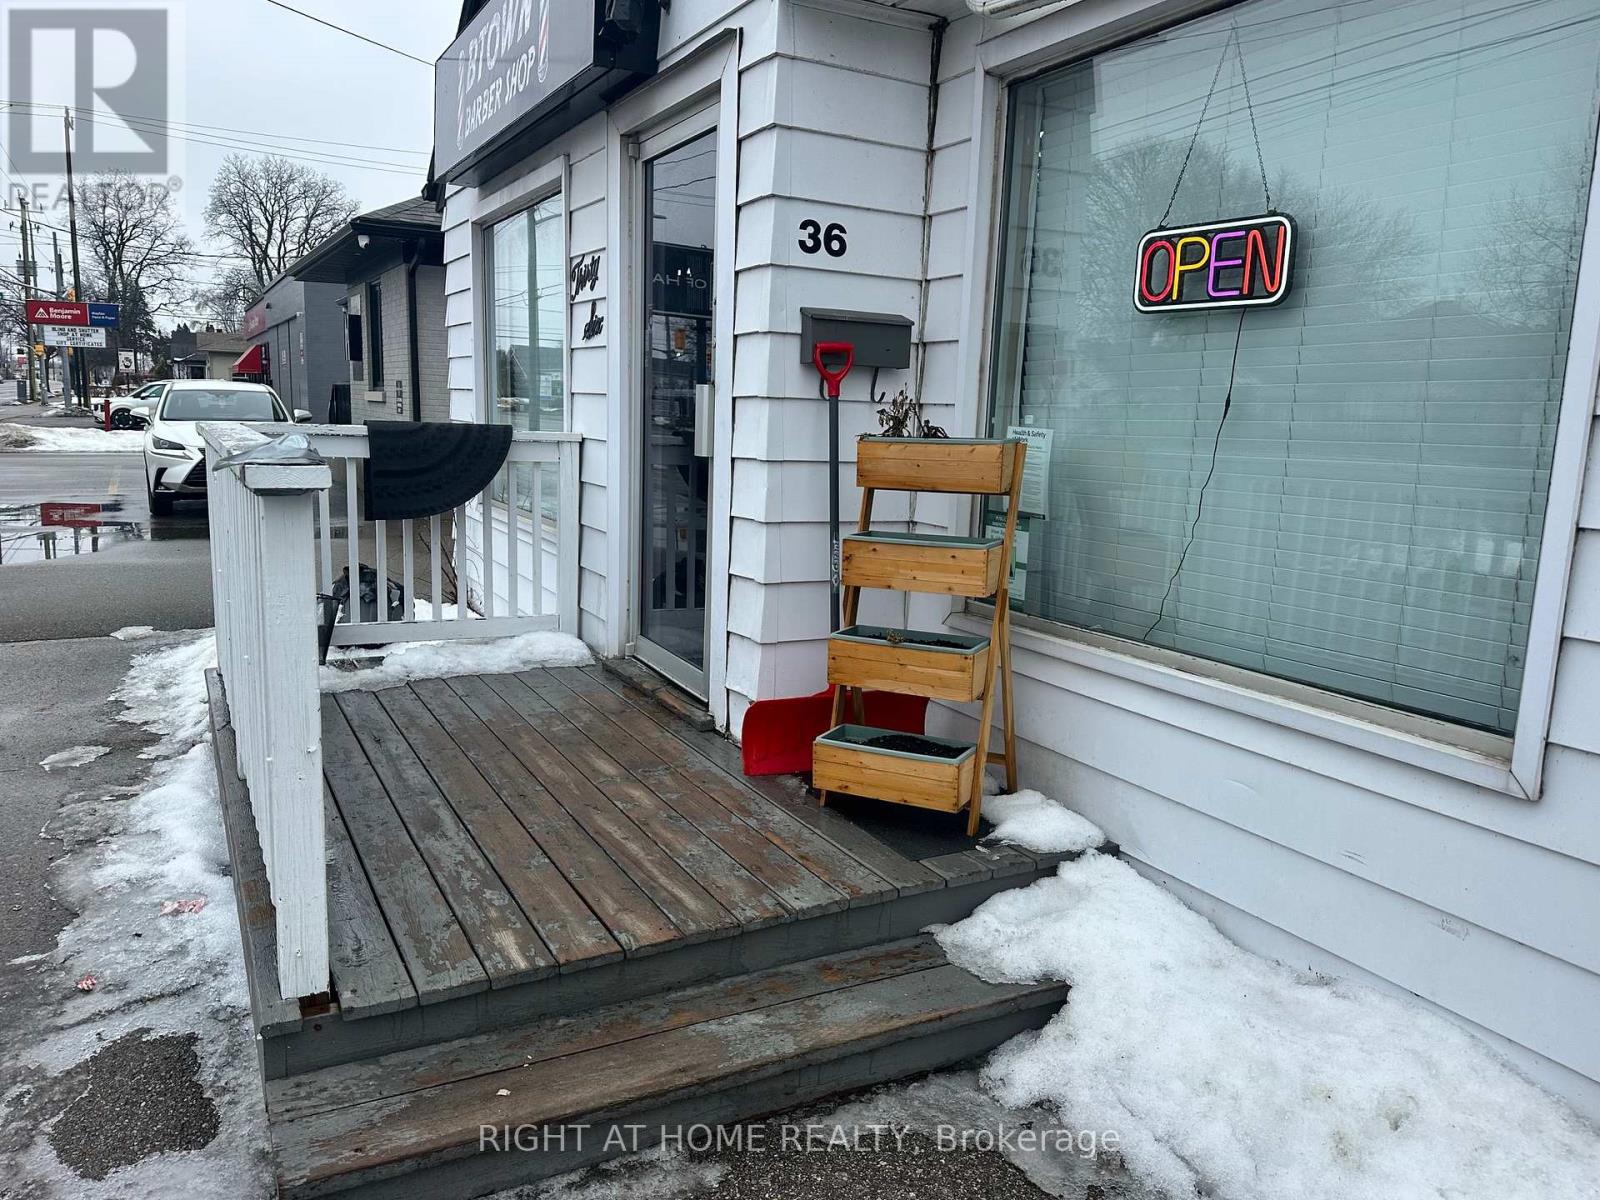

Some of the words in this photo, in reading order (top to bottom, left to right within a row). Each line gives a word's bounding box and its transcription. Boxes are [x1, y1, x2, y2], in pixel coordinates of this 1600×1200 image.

[465, 77, 502, 139] BARBER
[505, 45, 535, 104] SHOP
[798, 219, 847, 257] 36
[571, 254, 600, 301] Thirty
[1141, 225, 1285, 302] OPEN
[49, 307, 81, 315] Benjamin
[1012, 427, 1027, 437] Health
[1031, 430, 1047, 440] Safety
